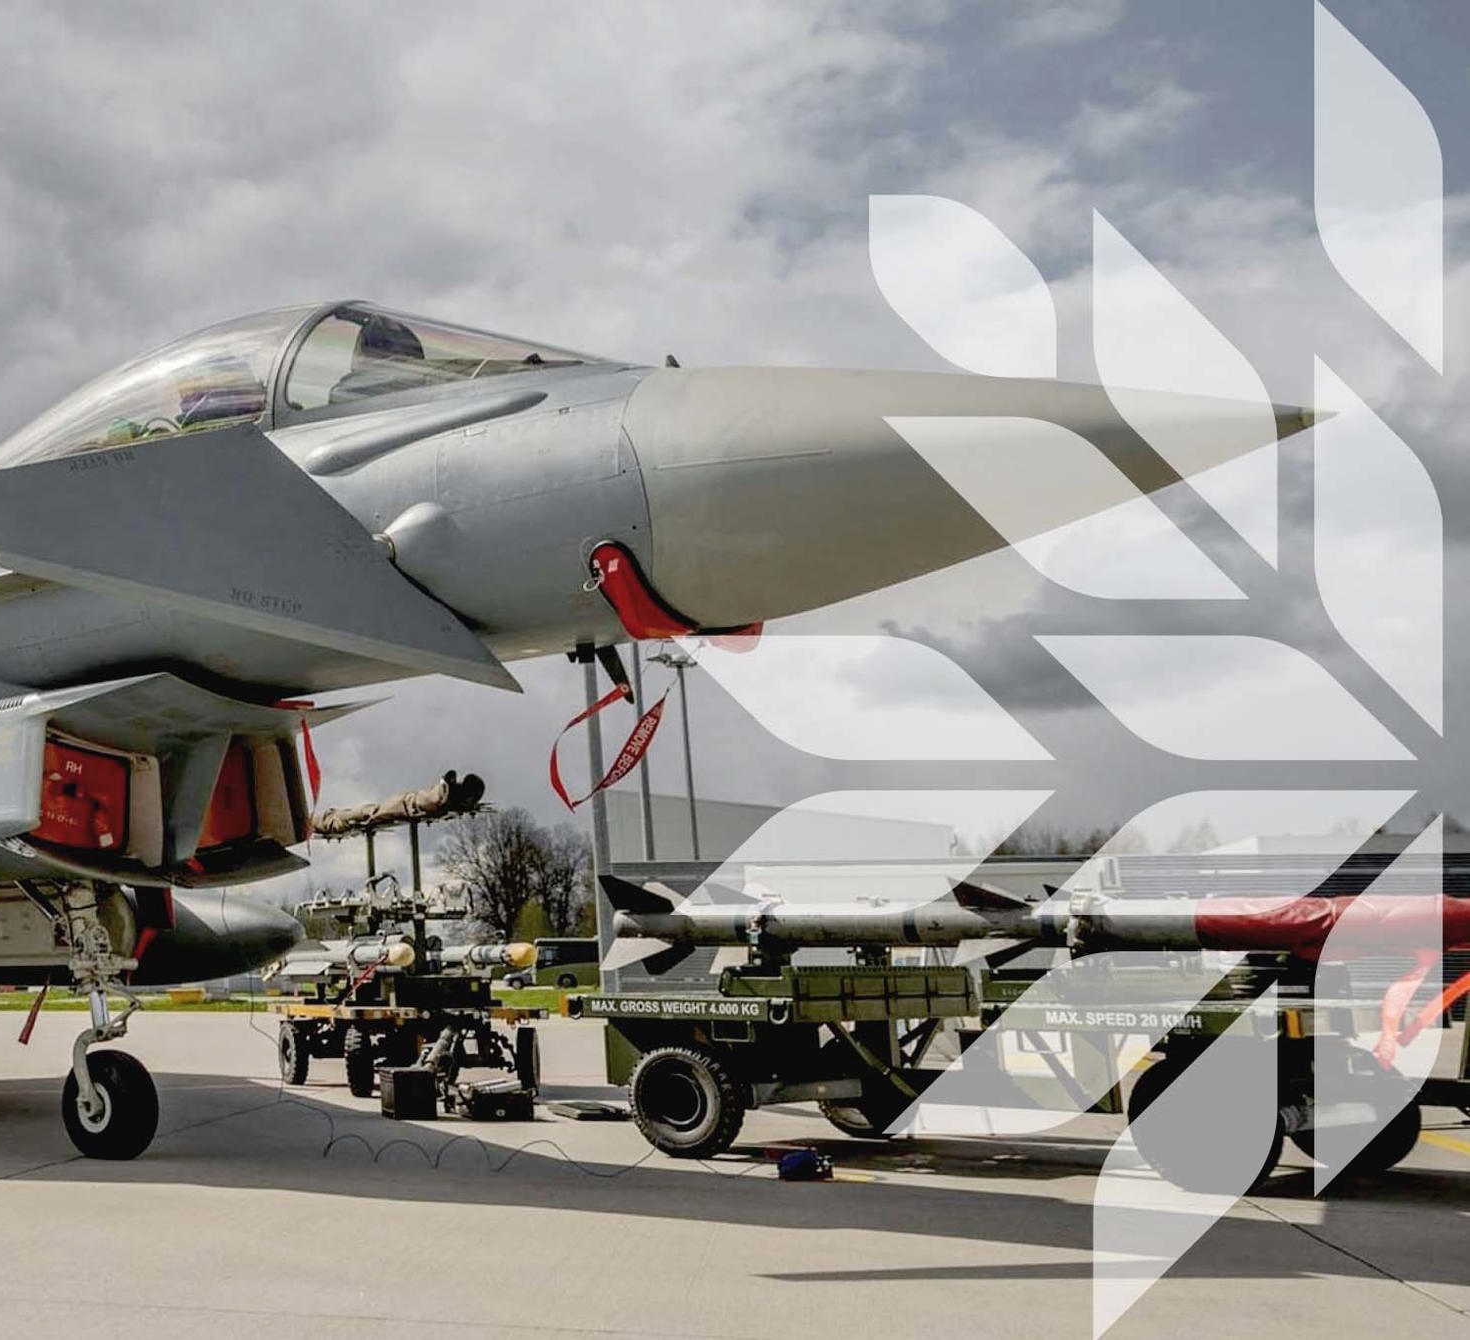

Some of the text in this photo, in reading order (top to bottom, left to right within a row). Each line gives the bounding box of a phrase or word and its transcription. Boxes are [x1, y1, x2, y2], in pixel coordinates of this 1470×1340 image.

[260, 595, 303, 615] STEP
[603, 714, 658, 785] REMOVE BEFO
[65, 760, 83, 775] RH
[591, 1000, 760, 1016] MAX. GROSS WEIGHT 4.000 KG
[1045, 1010, 1203, 1029] MAX. SPEED 20 KM/H
